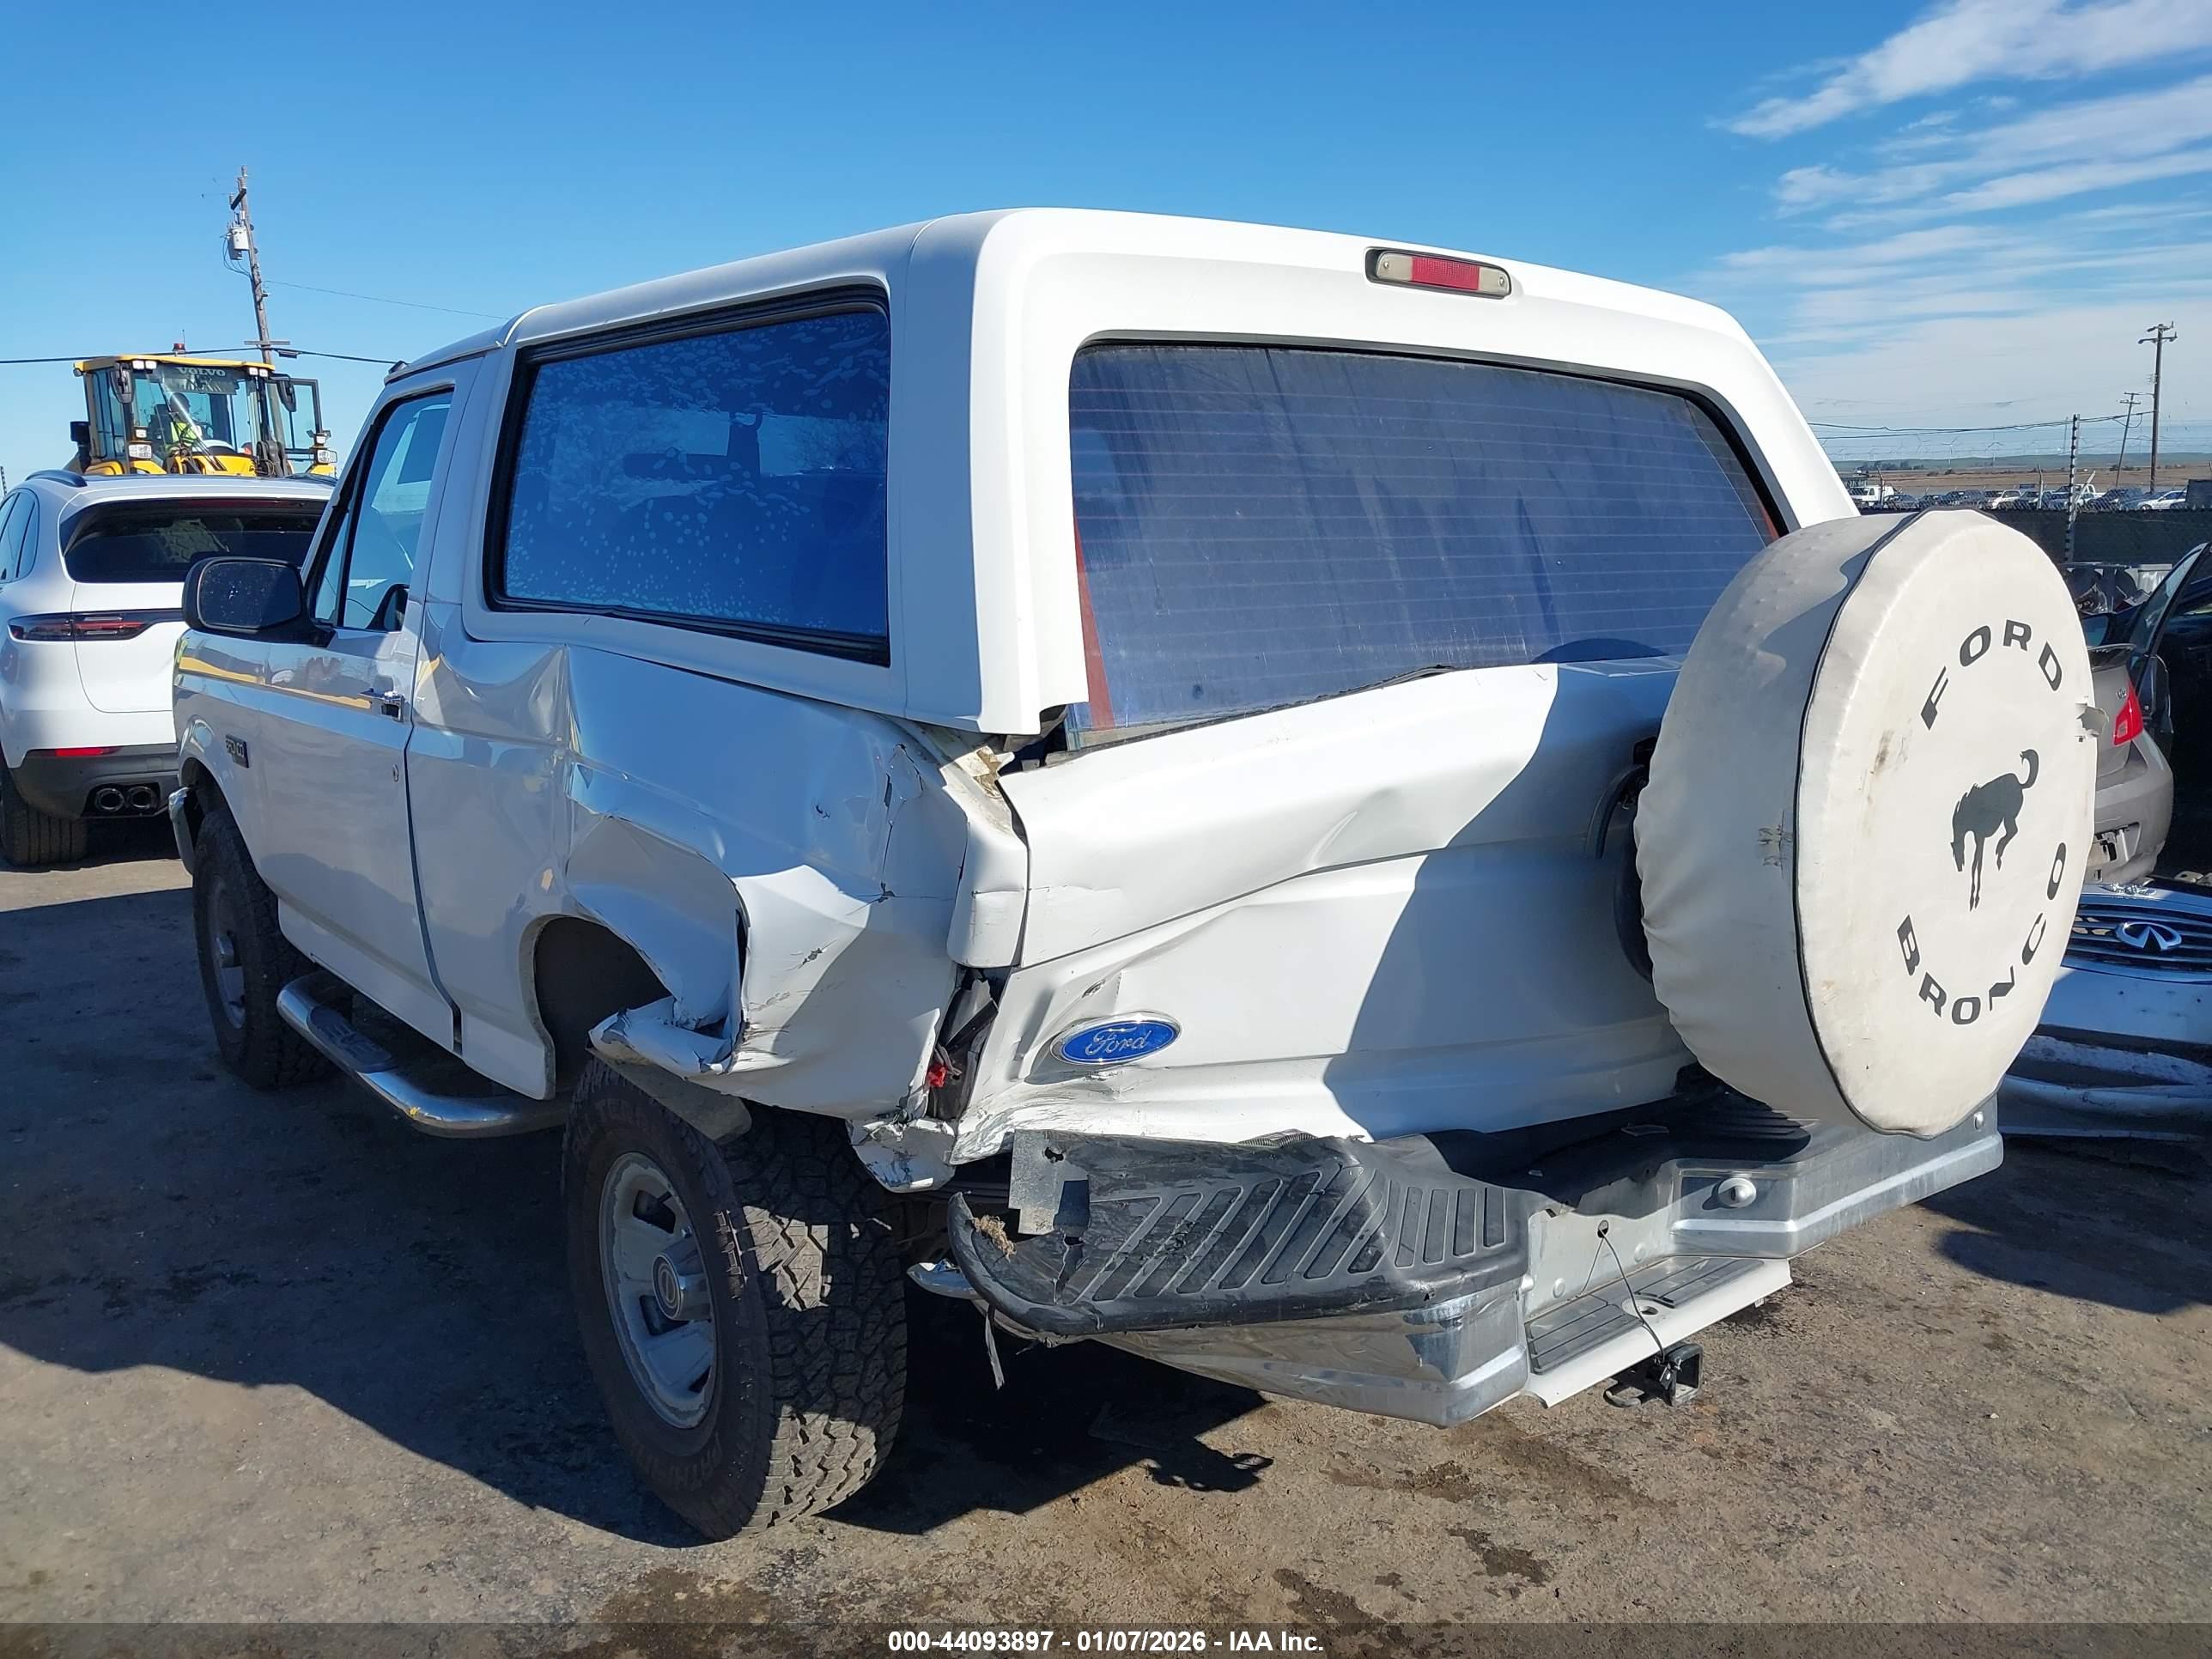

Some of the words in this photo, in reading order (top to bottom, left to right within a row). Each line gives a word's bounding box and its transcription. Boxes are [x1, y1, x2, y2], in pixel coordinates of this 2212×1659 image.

[177, 367, 226, 377] VOLVO
[1920, 619, 2063, 731] FORD
[1896, 842, 2068, 1025] BRONCO
[1085, 1026, 1153, 1056] Ford
